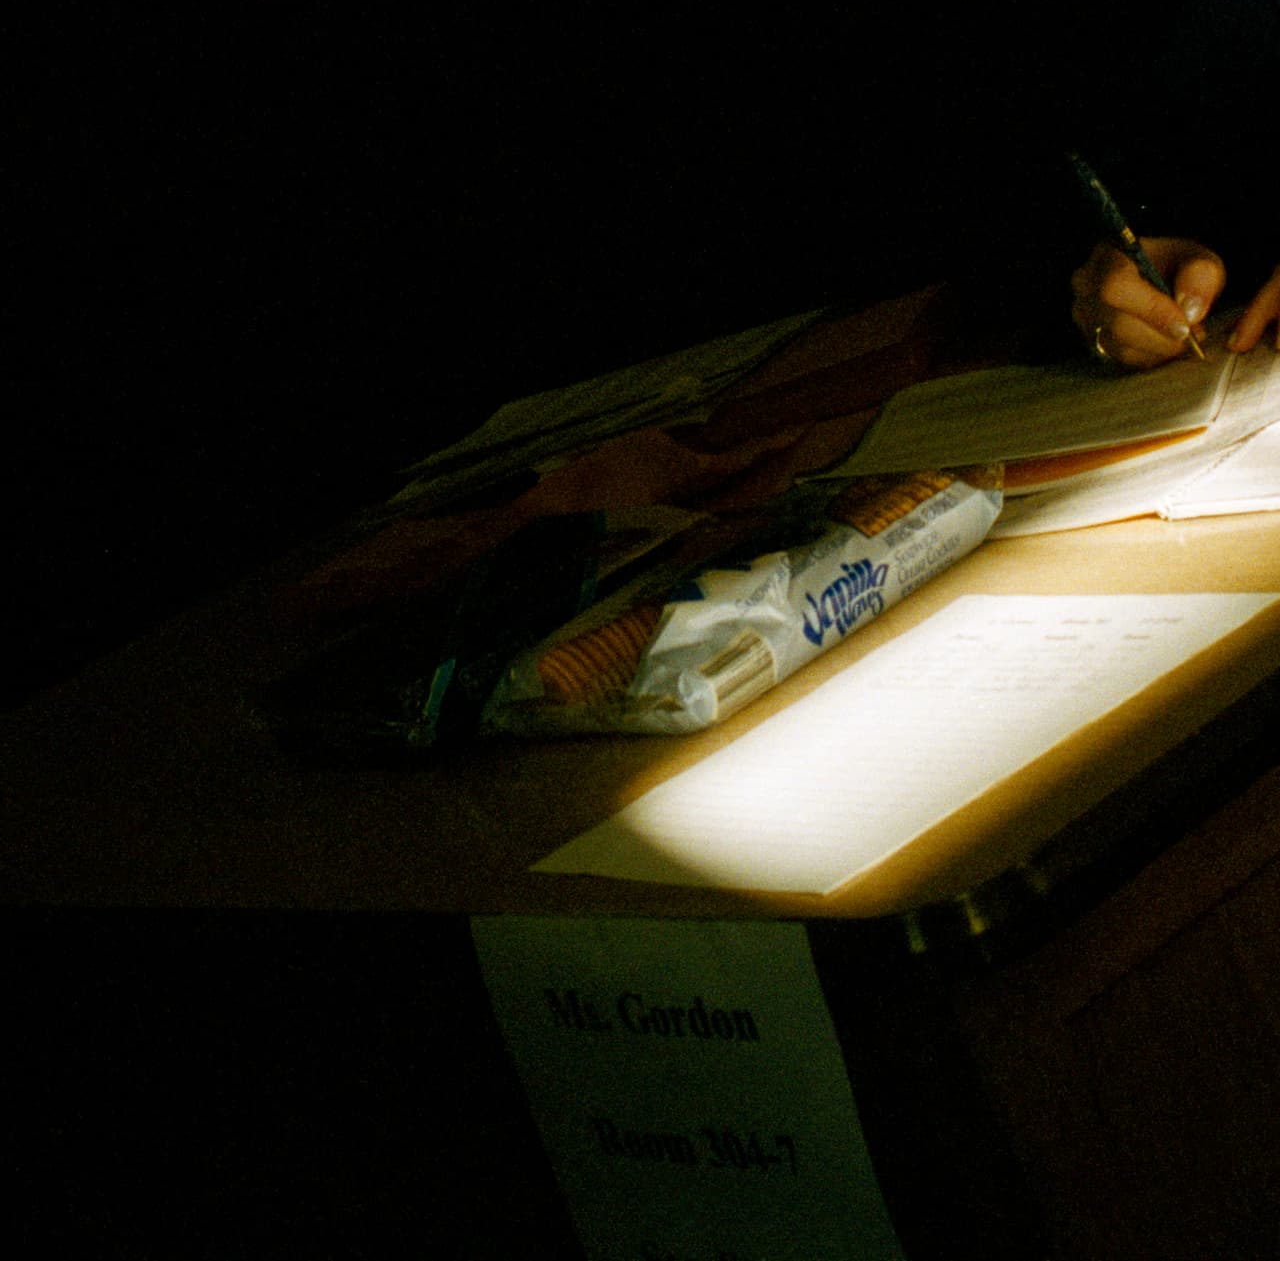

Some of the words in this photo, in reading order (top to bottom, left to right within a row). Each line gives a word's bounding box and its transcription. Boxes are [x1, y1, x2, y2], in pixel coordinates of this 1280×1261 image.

[616, 991, 761, 1042] Gordon
[590, 1117, 697, 1165] Room
[700, 1127, 799, 1177] 304-7
